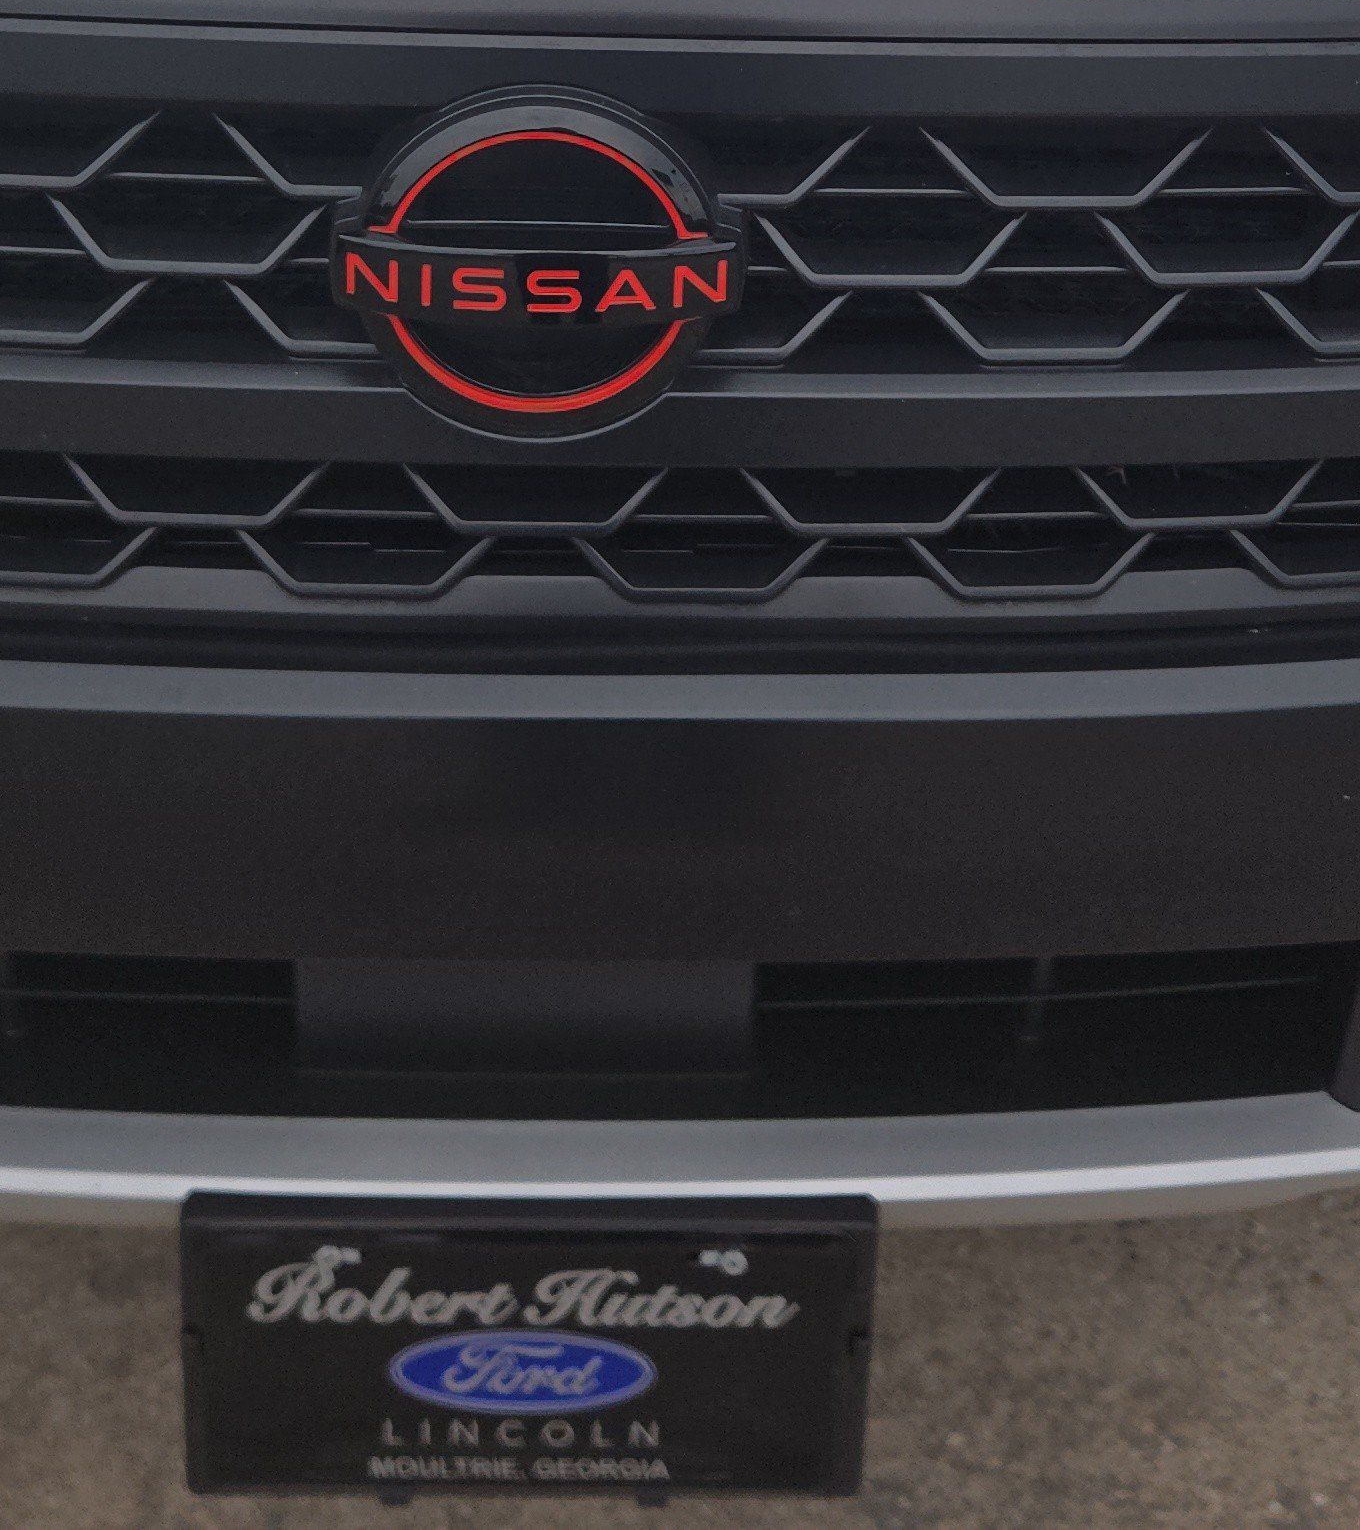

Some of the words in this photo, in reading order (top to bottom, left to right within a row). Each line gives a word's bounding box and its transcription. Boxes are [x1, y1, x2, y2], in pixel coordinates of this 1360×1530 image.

[346, 252, 728, 313] NISSAN
[247, 1260, 520, 1325] Robert
[524, 1268, 799, 1328] Hutson
[443, 1342, 604, 1396] Ford
[381, 1417, 660, 1448] LINCOLN
[532, 1456, 671, 1480] GEORGIA
